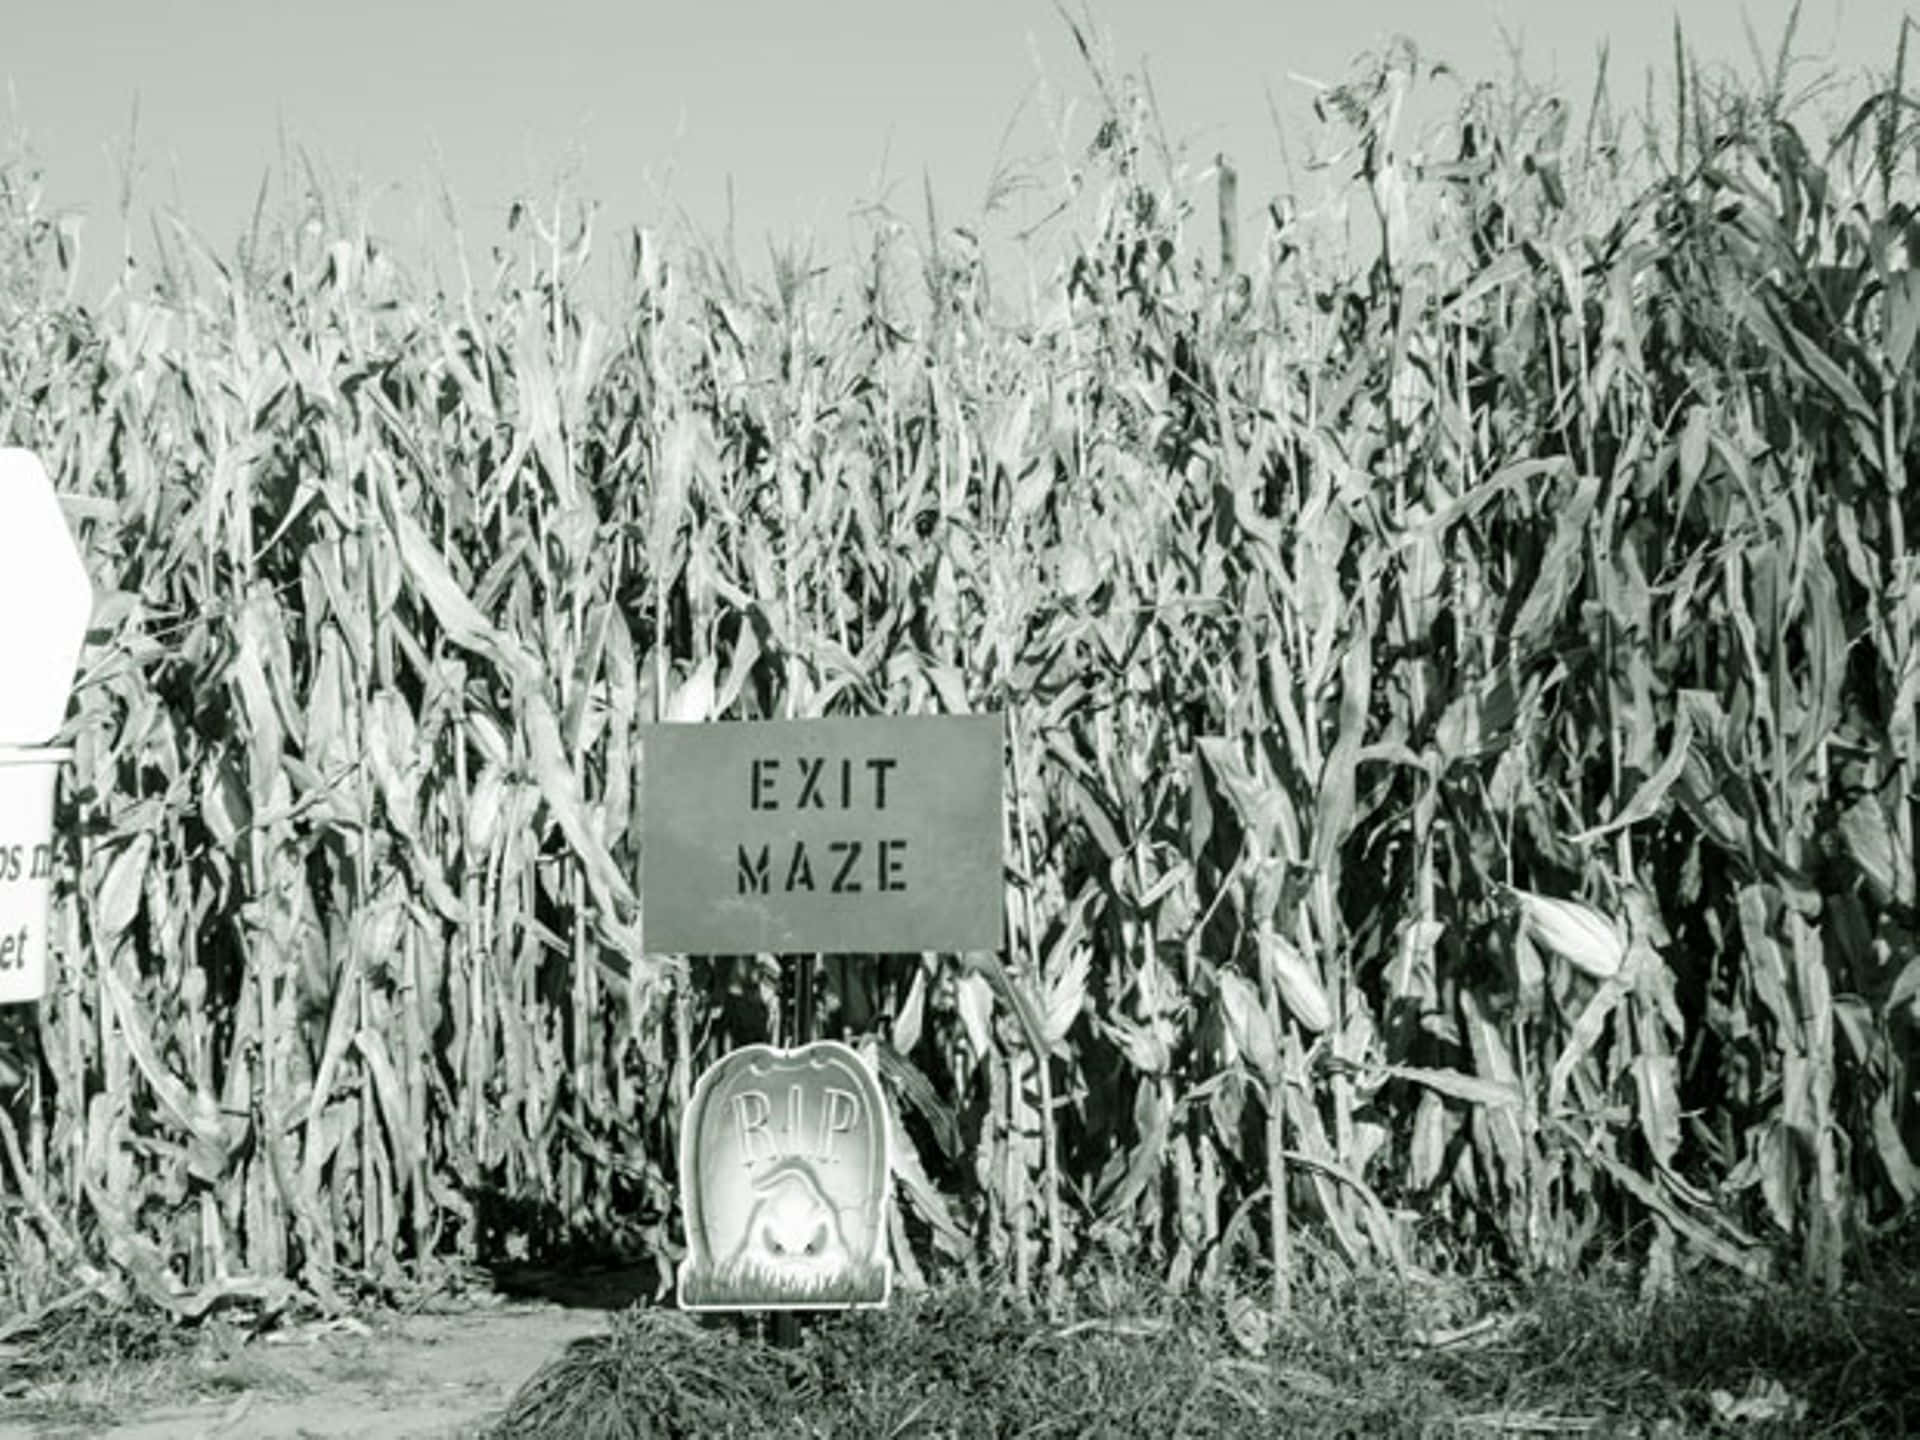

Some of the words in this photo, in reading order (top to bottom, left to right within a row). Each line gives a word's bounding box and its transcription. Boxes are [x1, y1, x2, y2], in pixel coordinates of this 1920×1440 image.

[751, 757, 897, 811] EXIT
[737, 840, 907, 895] MAZE
[731, 1083, 860, 1166] RIP
